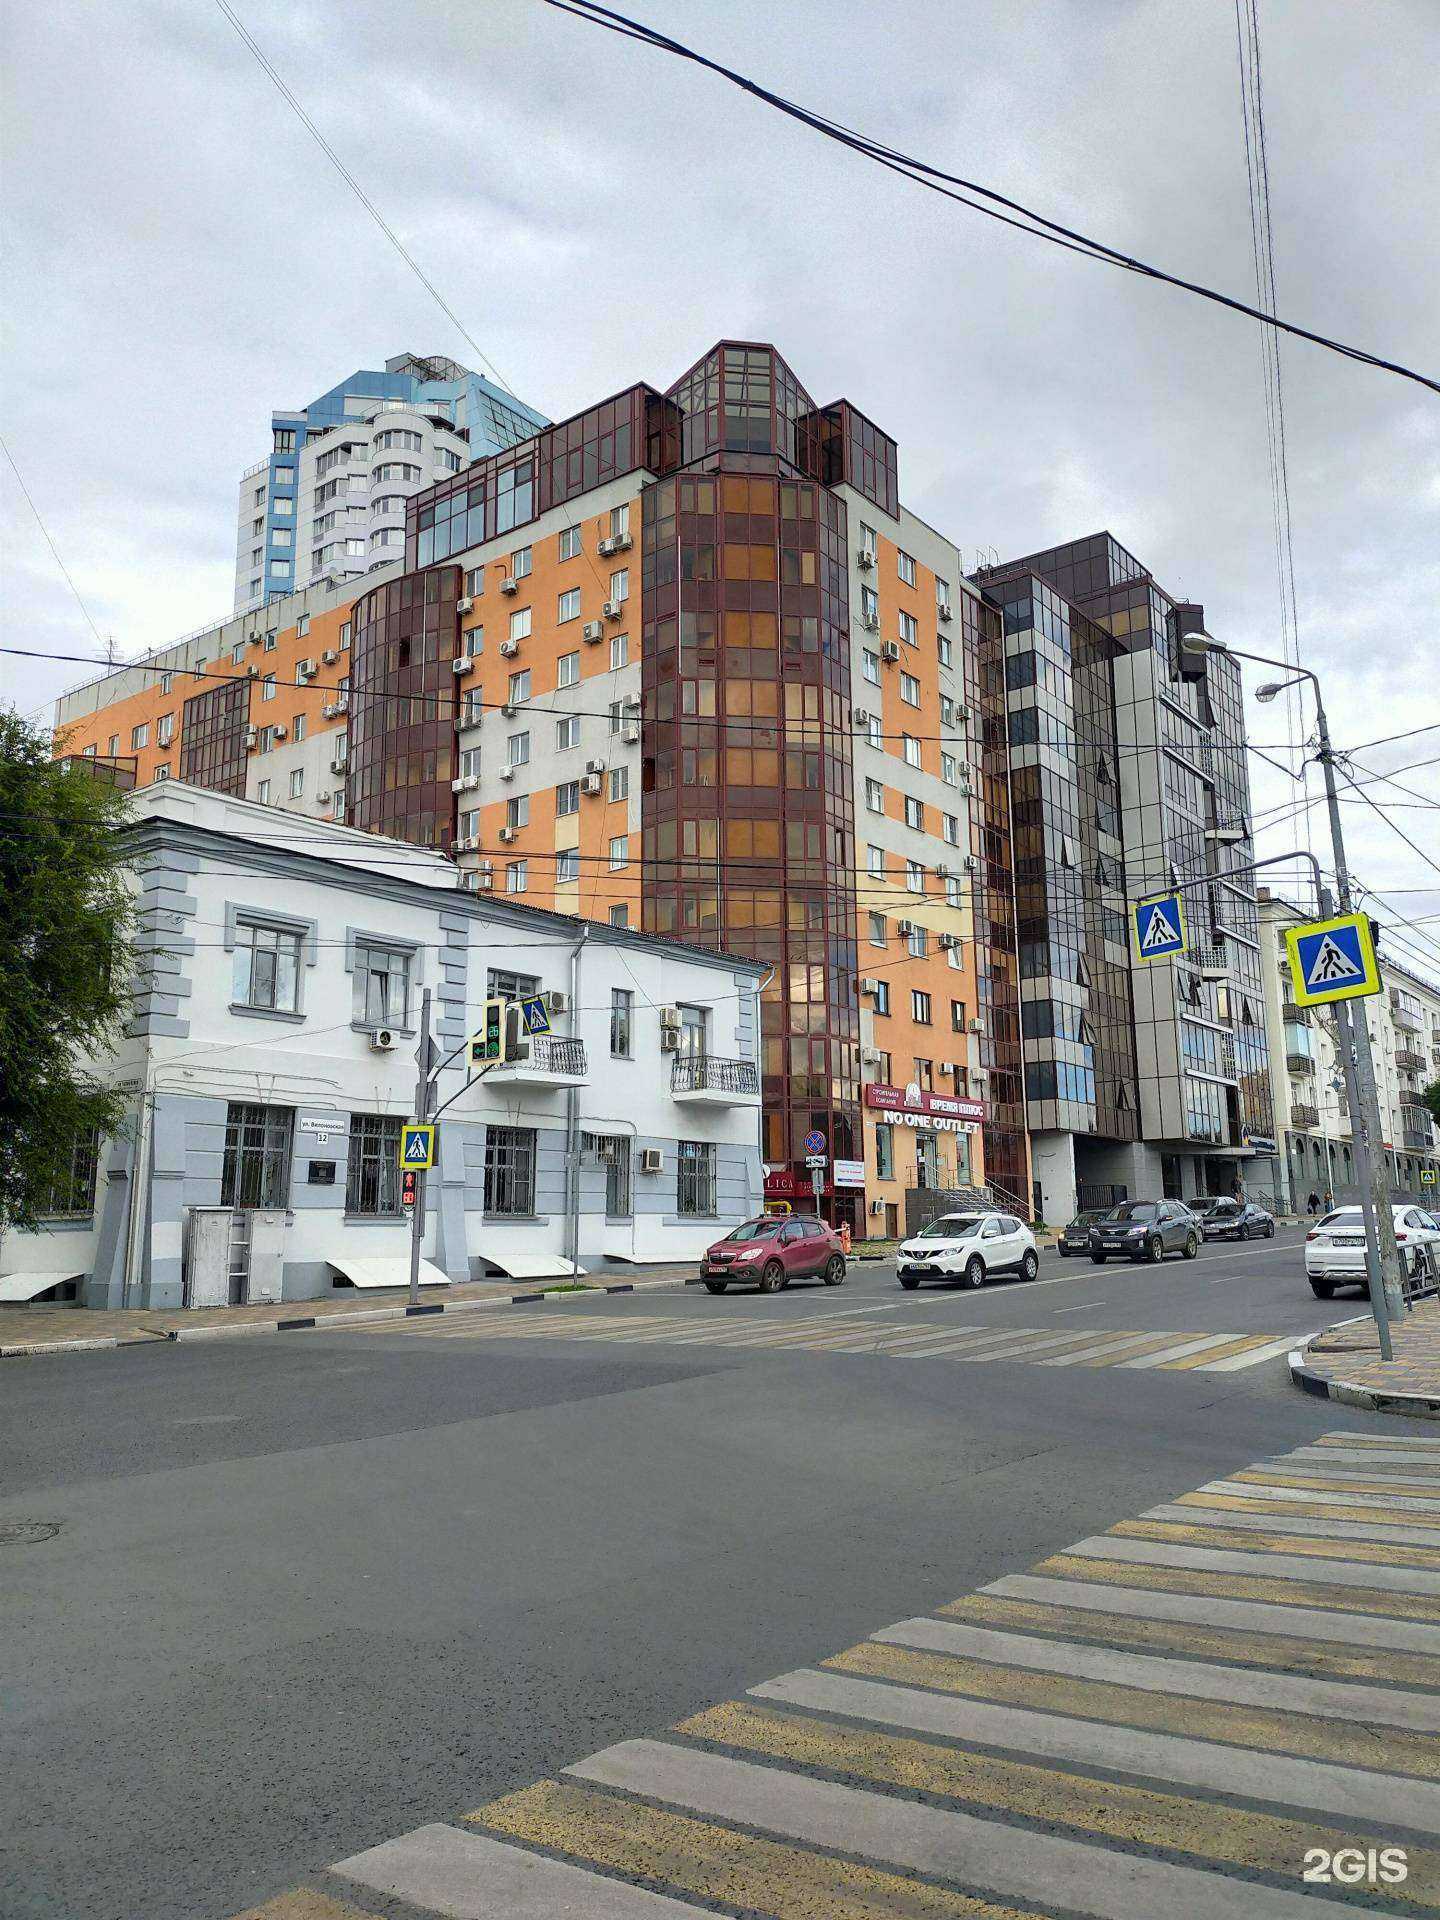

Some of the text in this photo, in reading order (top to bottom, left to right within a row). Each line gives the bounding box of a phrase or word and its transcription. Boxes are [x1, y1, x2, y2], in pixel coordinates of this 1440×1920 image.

[488, 1025, 499, 1037] 26
[929, 1098, 984, 1117] ВРЕМЯ ПЛЮС
[883, 1110, 903, 1125] NO
[904, 1113, 931, 1128] ONE
[933, 1117, 980, 1134] OUTLET
[318, 1134, 327, 1142] 12
